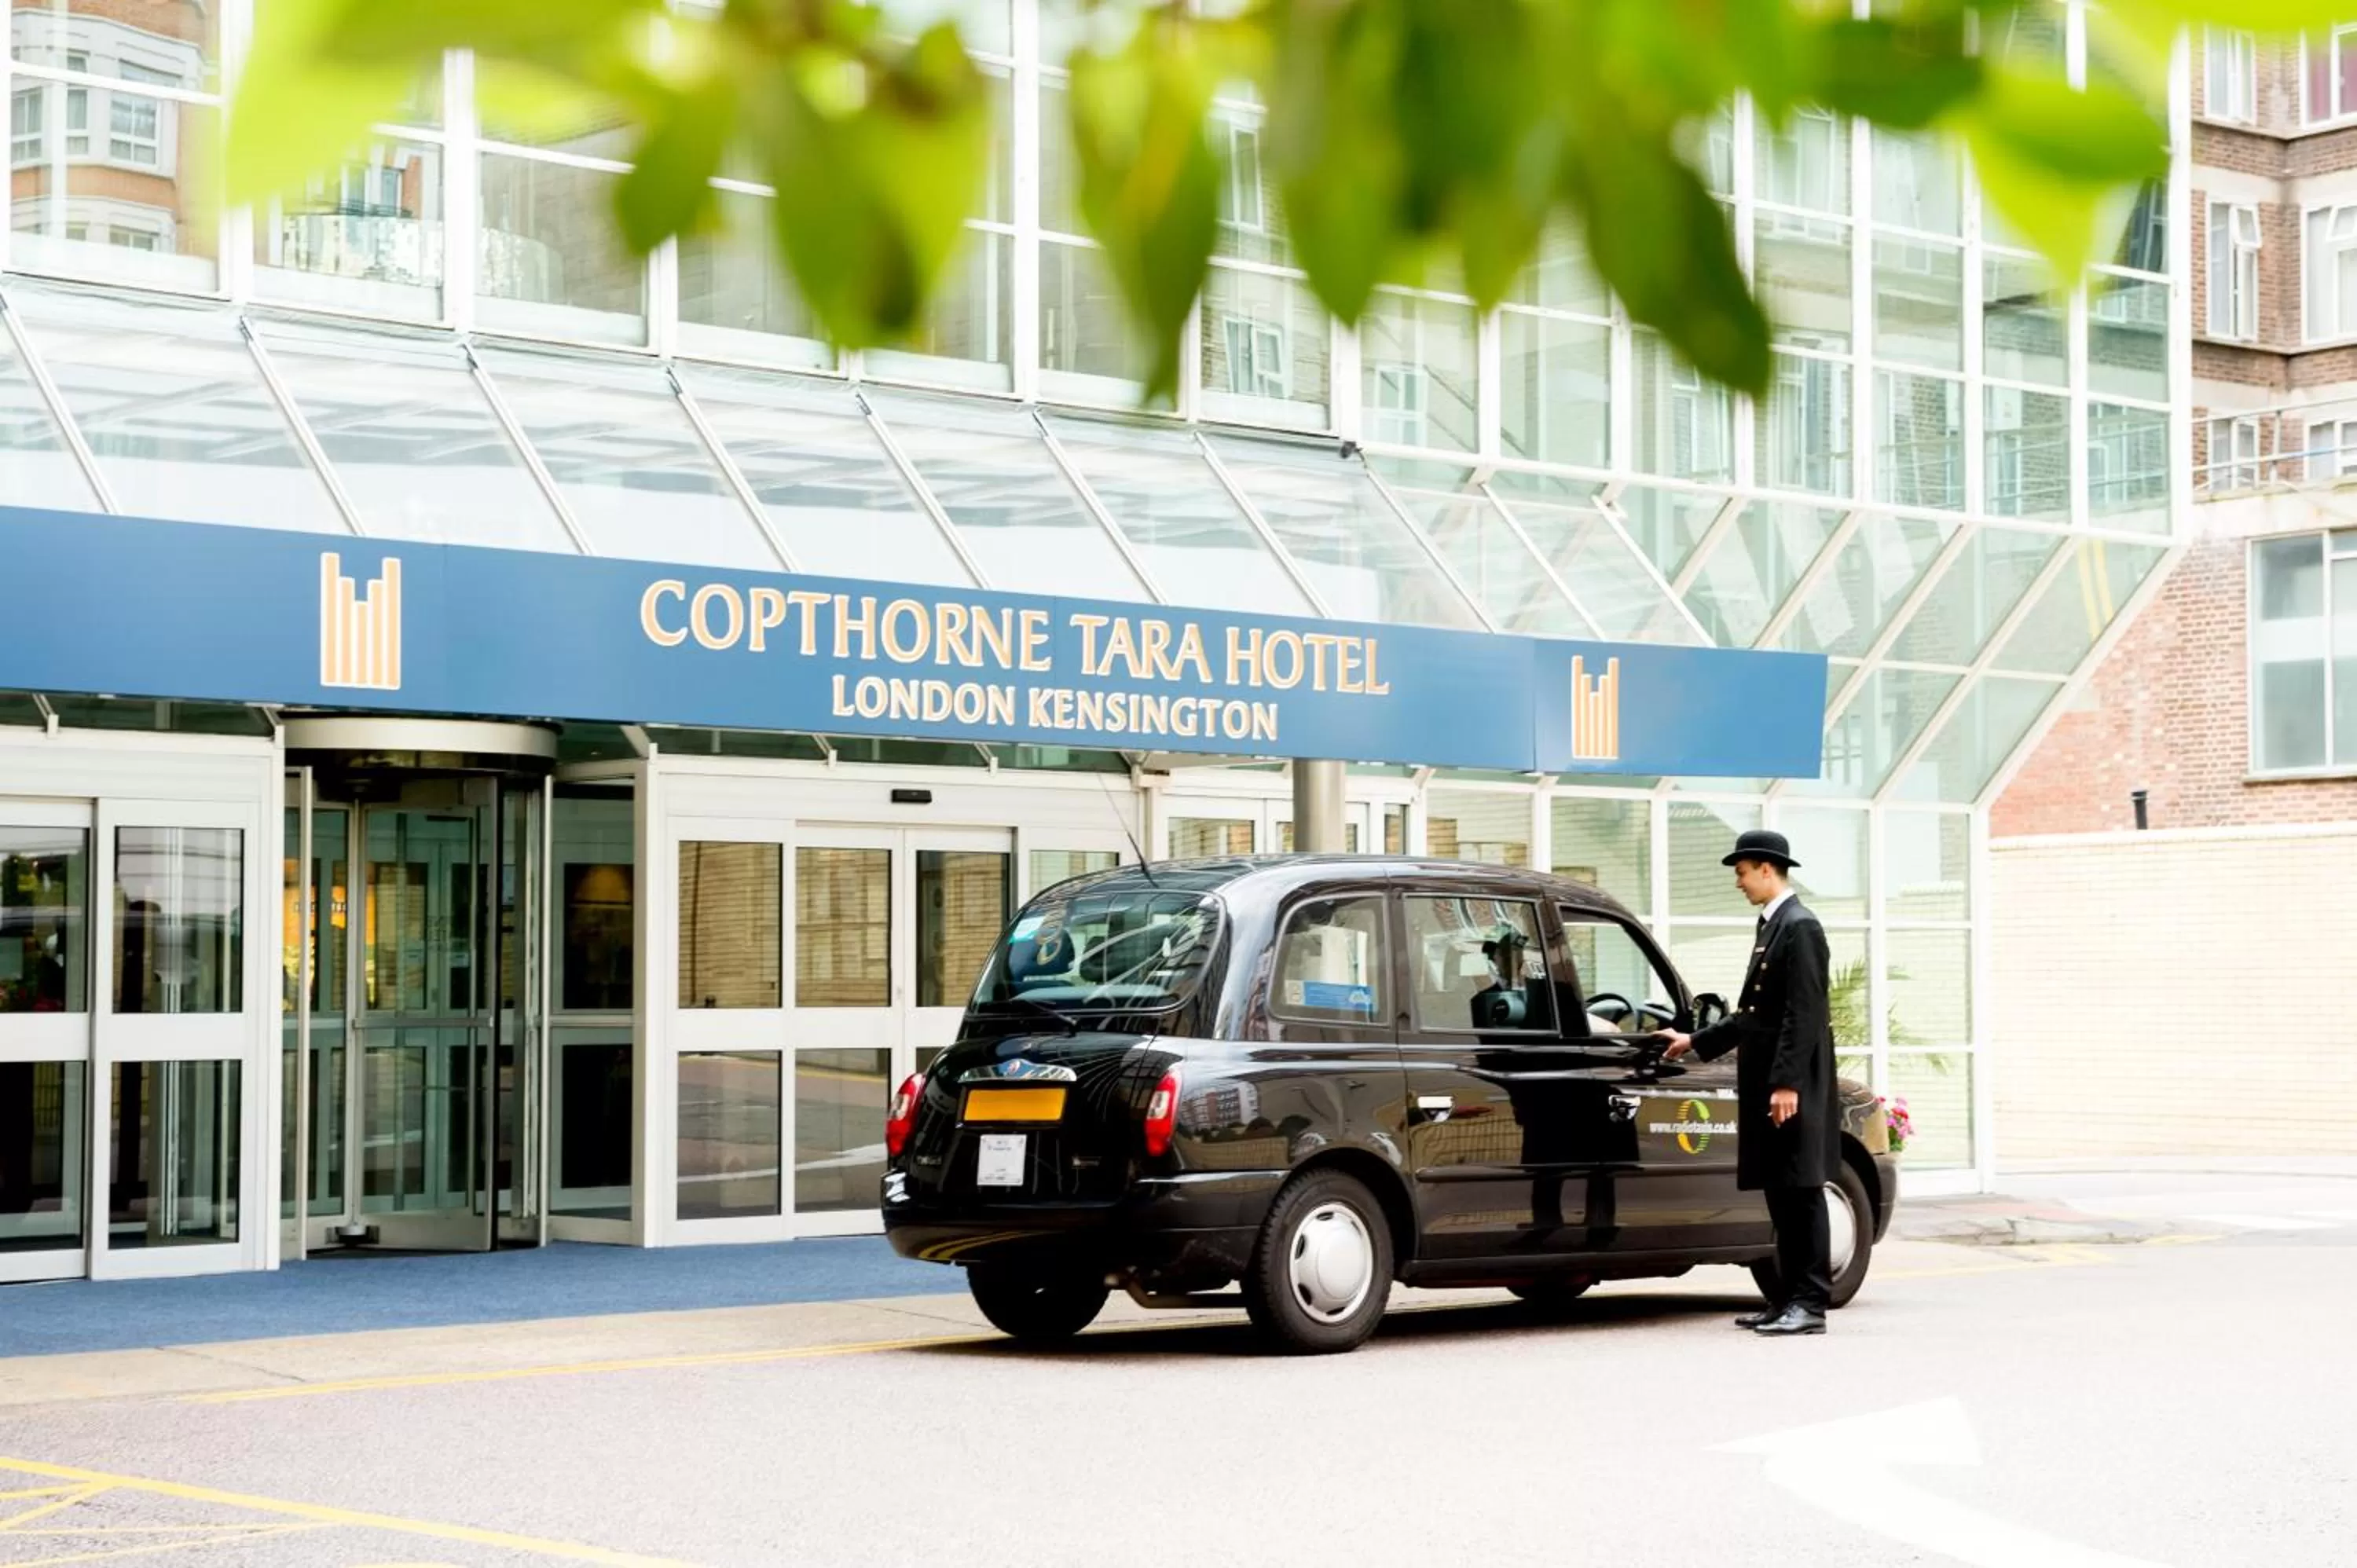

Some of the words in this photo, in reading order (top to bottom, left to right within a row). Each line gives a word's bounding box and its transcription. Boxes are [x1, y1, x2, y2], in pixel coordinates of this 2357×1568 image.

[640, 579, 1052, 671] COPTHORNE
[1069, 614, 1213, 683] TARA
[1226, 626, 1390, 695] HOTEL
[832, 674, 1015, 726] LONDON
[1028, 687, 1277, 741] KENSINGTON
